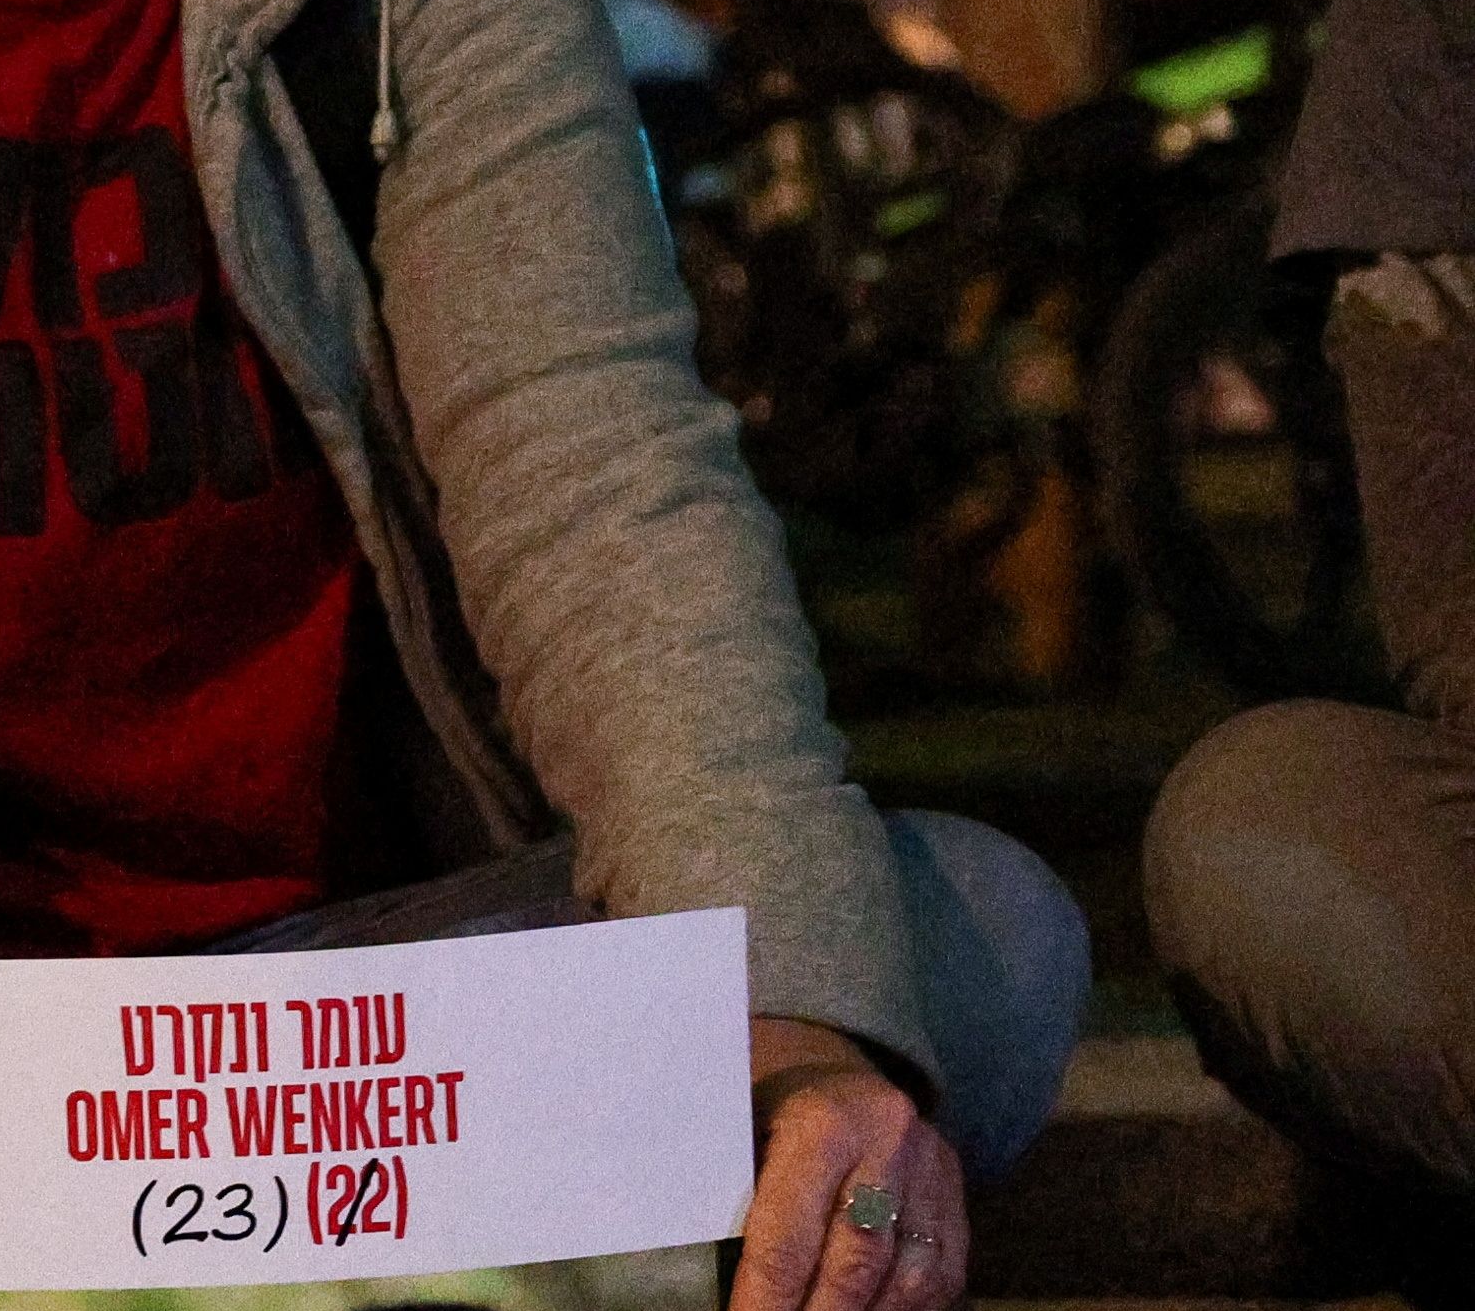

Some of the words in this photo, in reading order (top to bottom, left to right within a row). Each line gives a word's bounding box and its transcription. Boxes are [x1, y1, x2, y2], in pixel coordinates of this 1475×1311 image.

[120, 1002, 269, 1084] ונקרט
[286, 993, 407, 1068] עומר
[65, 1088, 211, 1163] OMER
[225, 1070, 465, 1157] WENKERT
[131, 1174, 290, 1257] (23)
